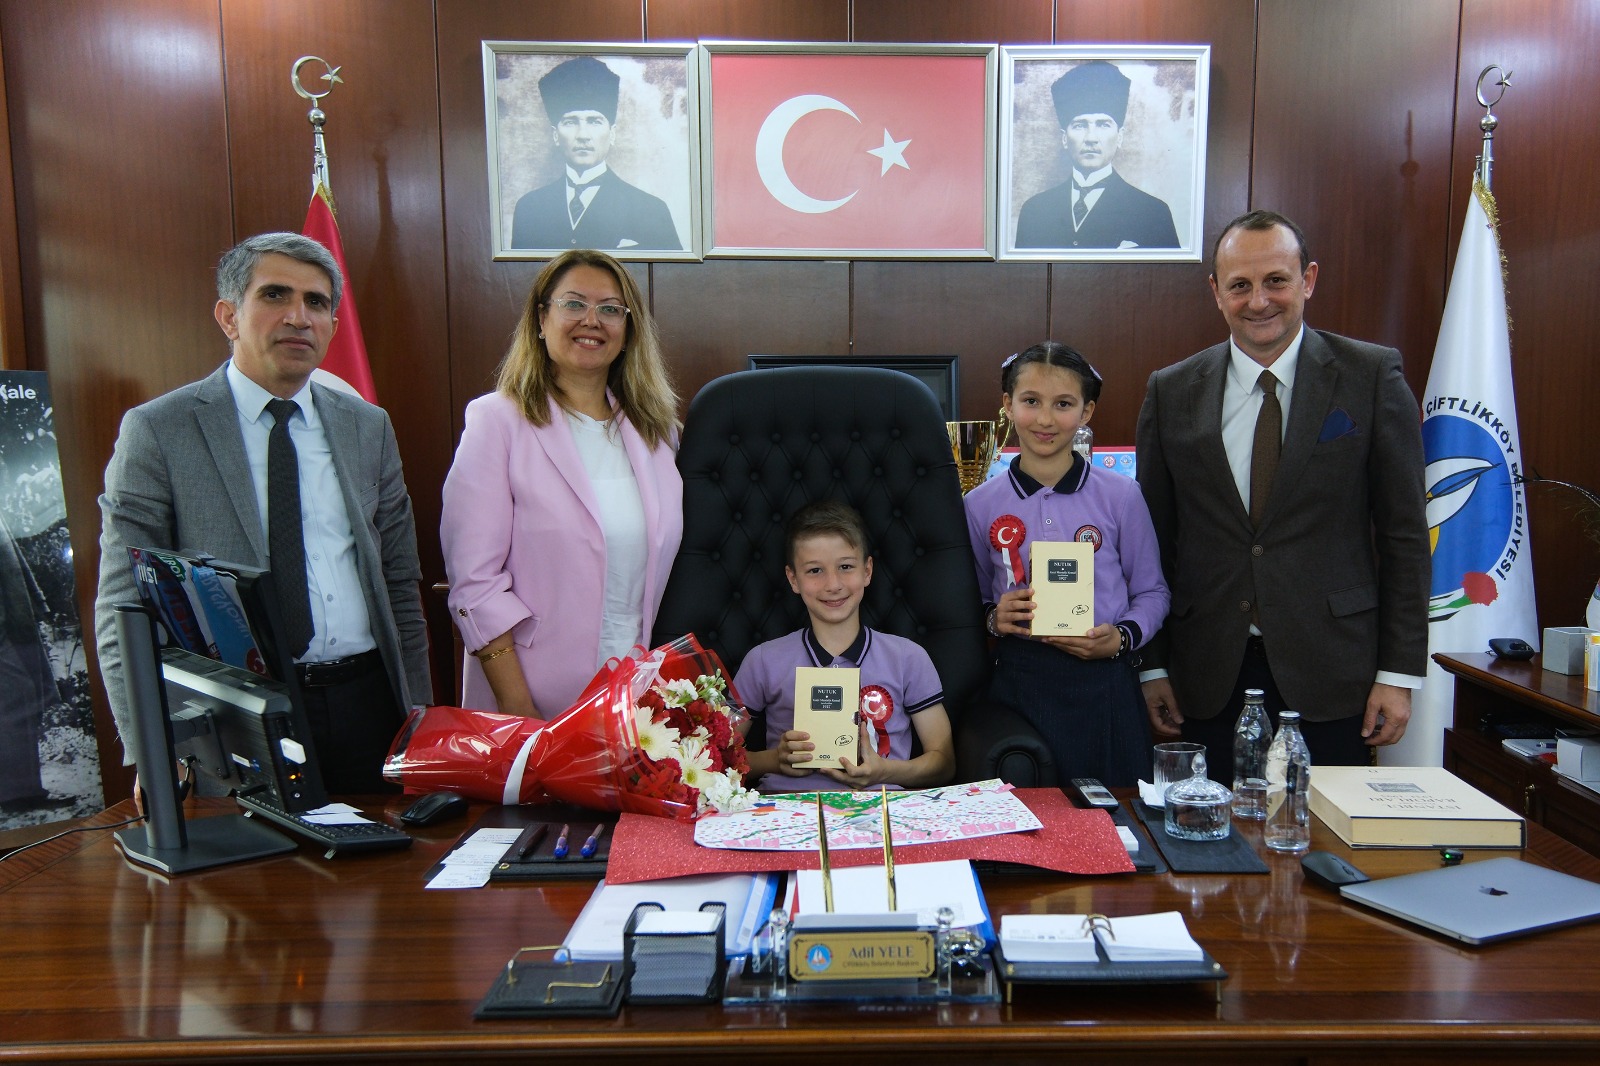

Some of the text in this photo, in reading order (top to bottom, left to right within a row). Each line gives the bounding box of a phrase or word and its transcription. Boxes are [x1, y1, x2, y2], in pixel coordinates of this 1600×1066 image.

[1426, 396, 1514, 454] ÇİFTLİKKÖY
[849, 945, 914, 959] Adil YELE
